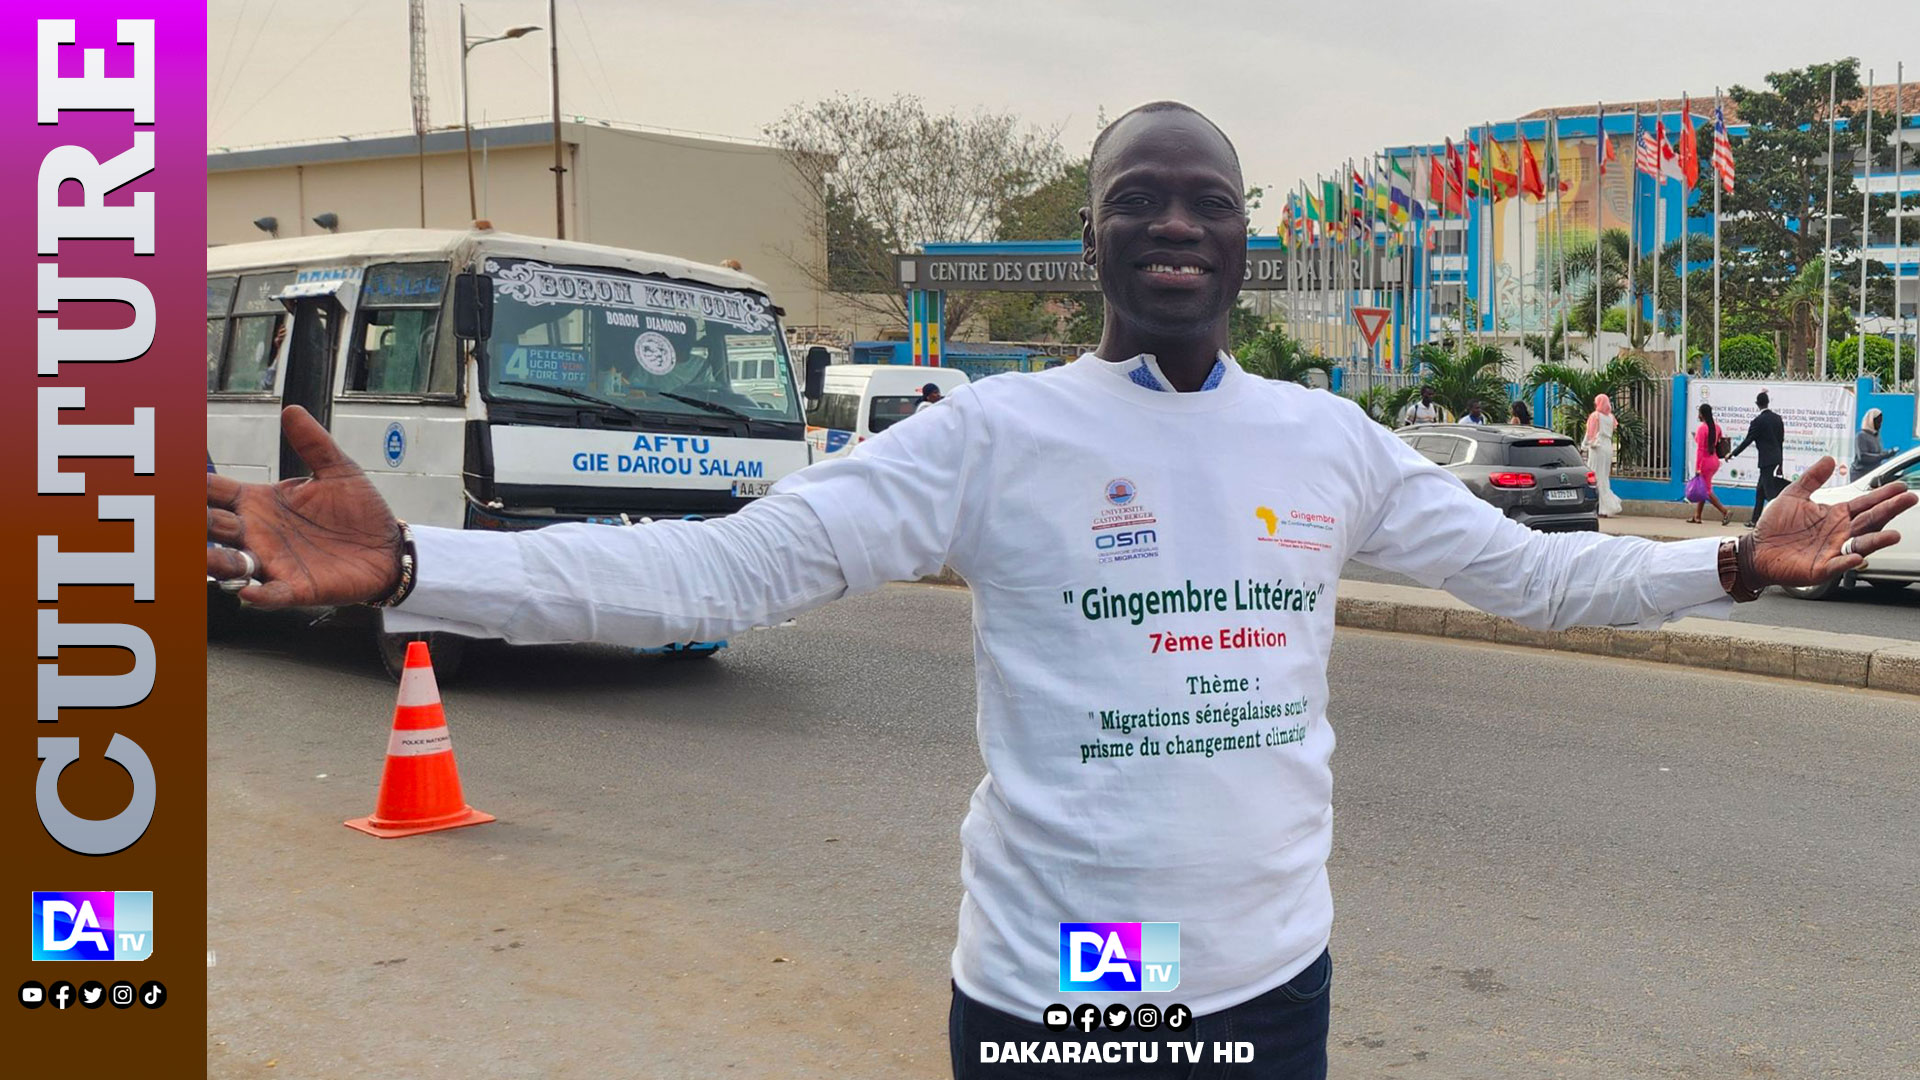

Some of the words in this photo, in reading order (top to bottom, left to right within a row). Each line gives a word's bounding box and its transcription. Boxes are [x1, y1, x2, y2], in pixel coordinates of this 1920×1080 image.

[929, 261, 989, 281] CENTRE
[993, 261, 1023, 281] DES
[1258, 259, 1284, 280] DE
[539, 273, 633, 303] BOROM
[605, 311, 640, 328] BOROM
[645, 316, 687, 335] DIAMONO
[505, 347, 529, 379] 4
[633, 434, 710, 455] AFTU
[572, 452, 609, 472] GIE
[617, 454, 692, 476] DAROU
[699, 458, 763, 479] SALAM
[1290, 510, 1336, 524] Gingembre
[1114, 551, 1159, 562] MIGRATIONS
[1081, 579, 1227, 626] Gingembre
[1149, 631, 1214, 654] 7ème
[1219, 626, 1287, 649] Edition
[1186, 673, 1249, 695] Thème
[1099, 708, 1190, 734] Migrations
[1195, 701, 1282, 727] sénégalaises
[1080, 741, 1134, 764] prisme
[1140, 736, 1161, 756] du
[1166, 729, 1261, 759] changement
